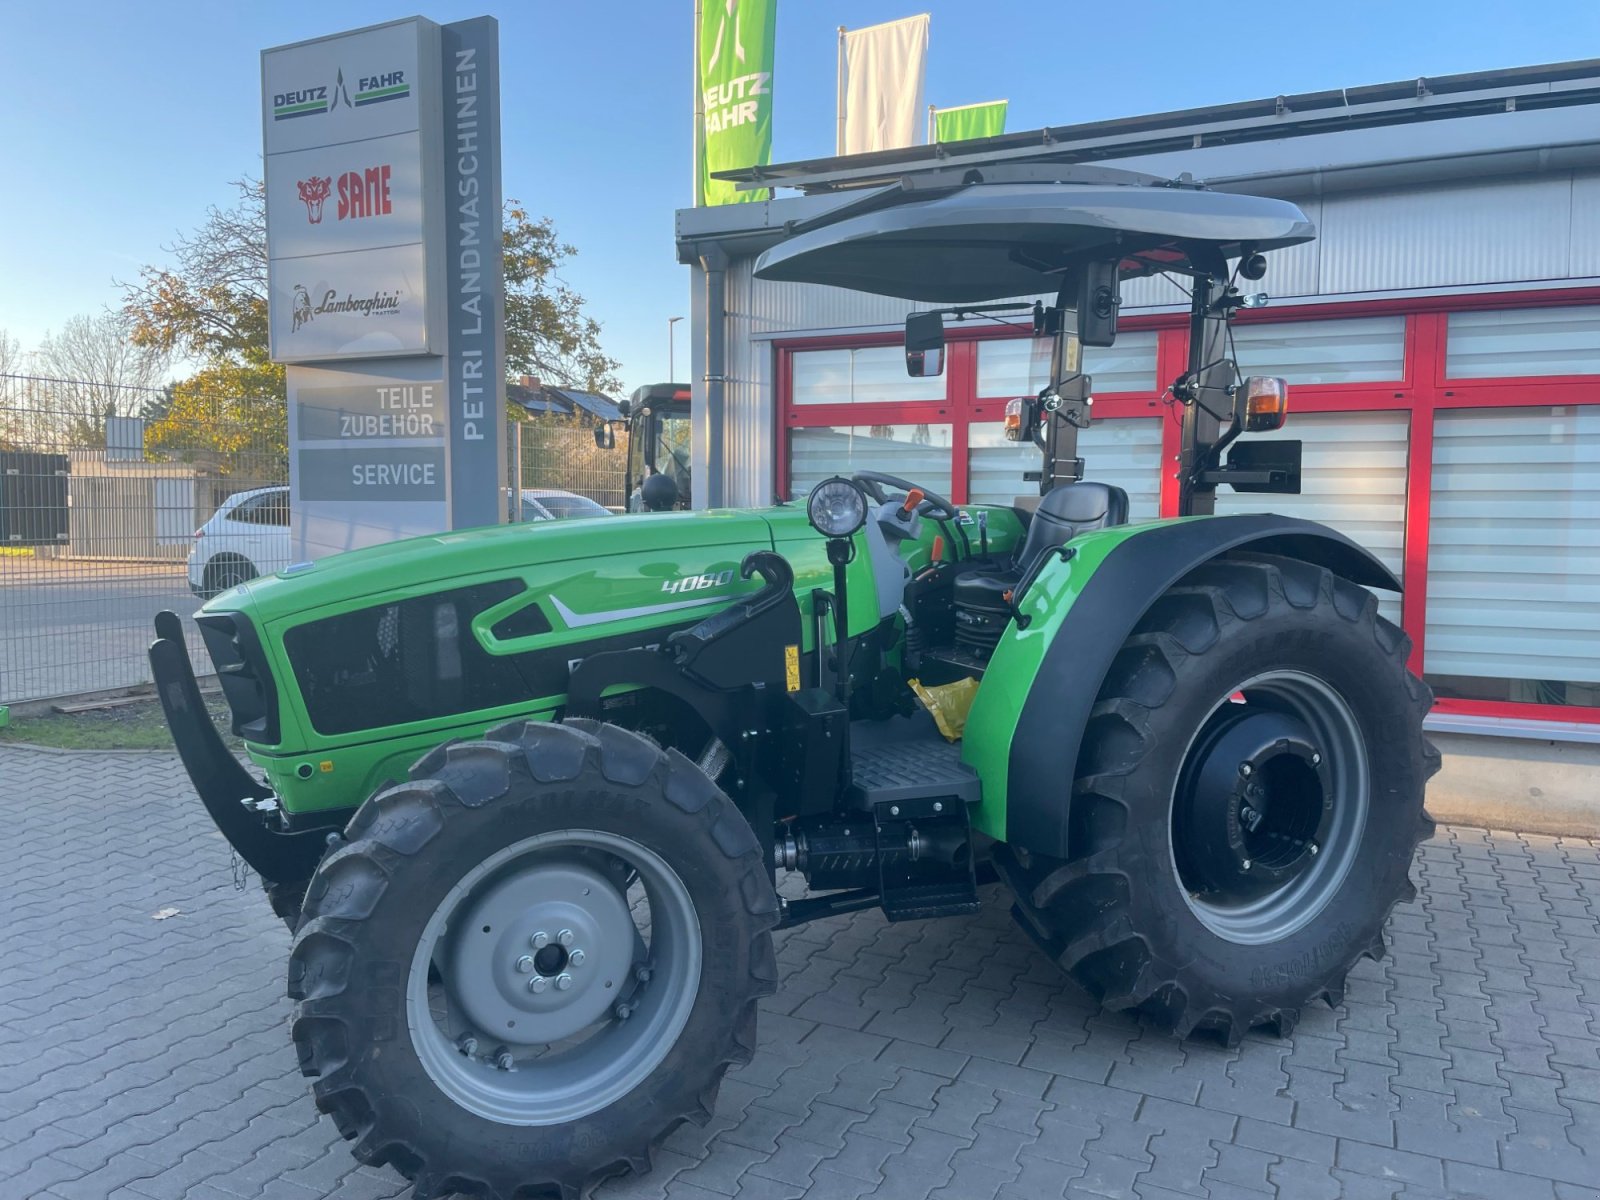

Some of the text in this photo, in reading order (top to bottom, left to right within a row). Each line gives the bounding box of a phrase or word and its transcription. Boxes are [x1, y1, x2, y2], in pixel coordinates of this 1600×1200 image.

[273, 71, 404, 107] DEUTZ FAHR
[337, 165, 392, 221] SAME
[455, 48, 484, 441] PETRI LANDMASCHINEN
[314, 289, 400, 316] Lamborghini
[377, 386, 433, 409] TEILE
[340, 409, 434, 437] ZUBEHÖR
[352, 463, 436, 485] SERVICE
